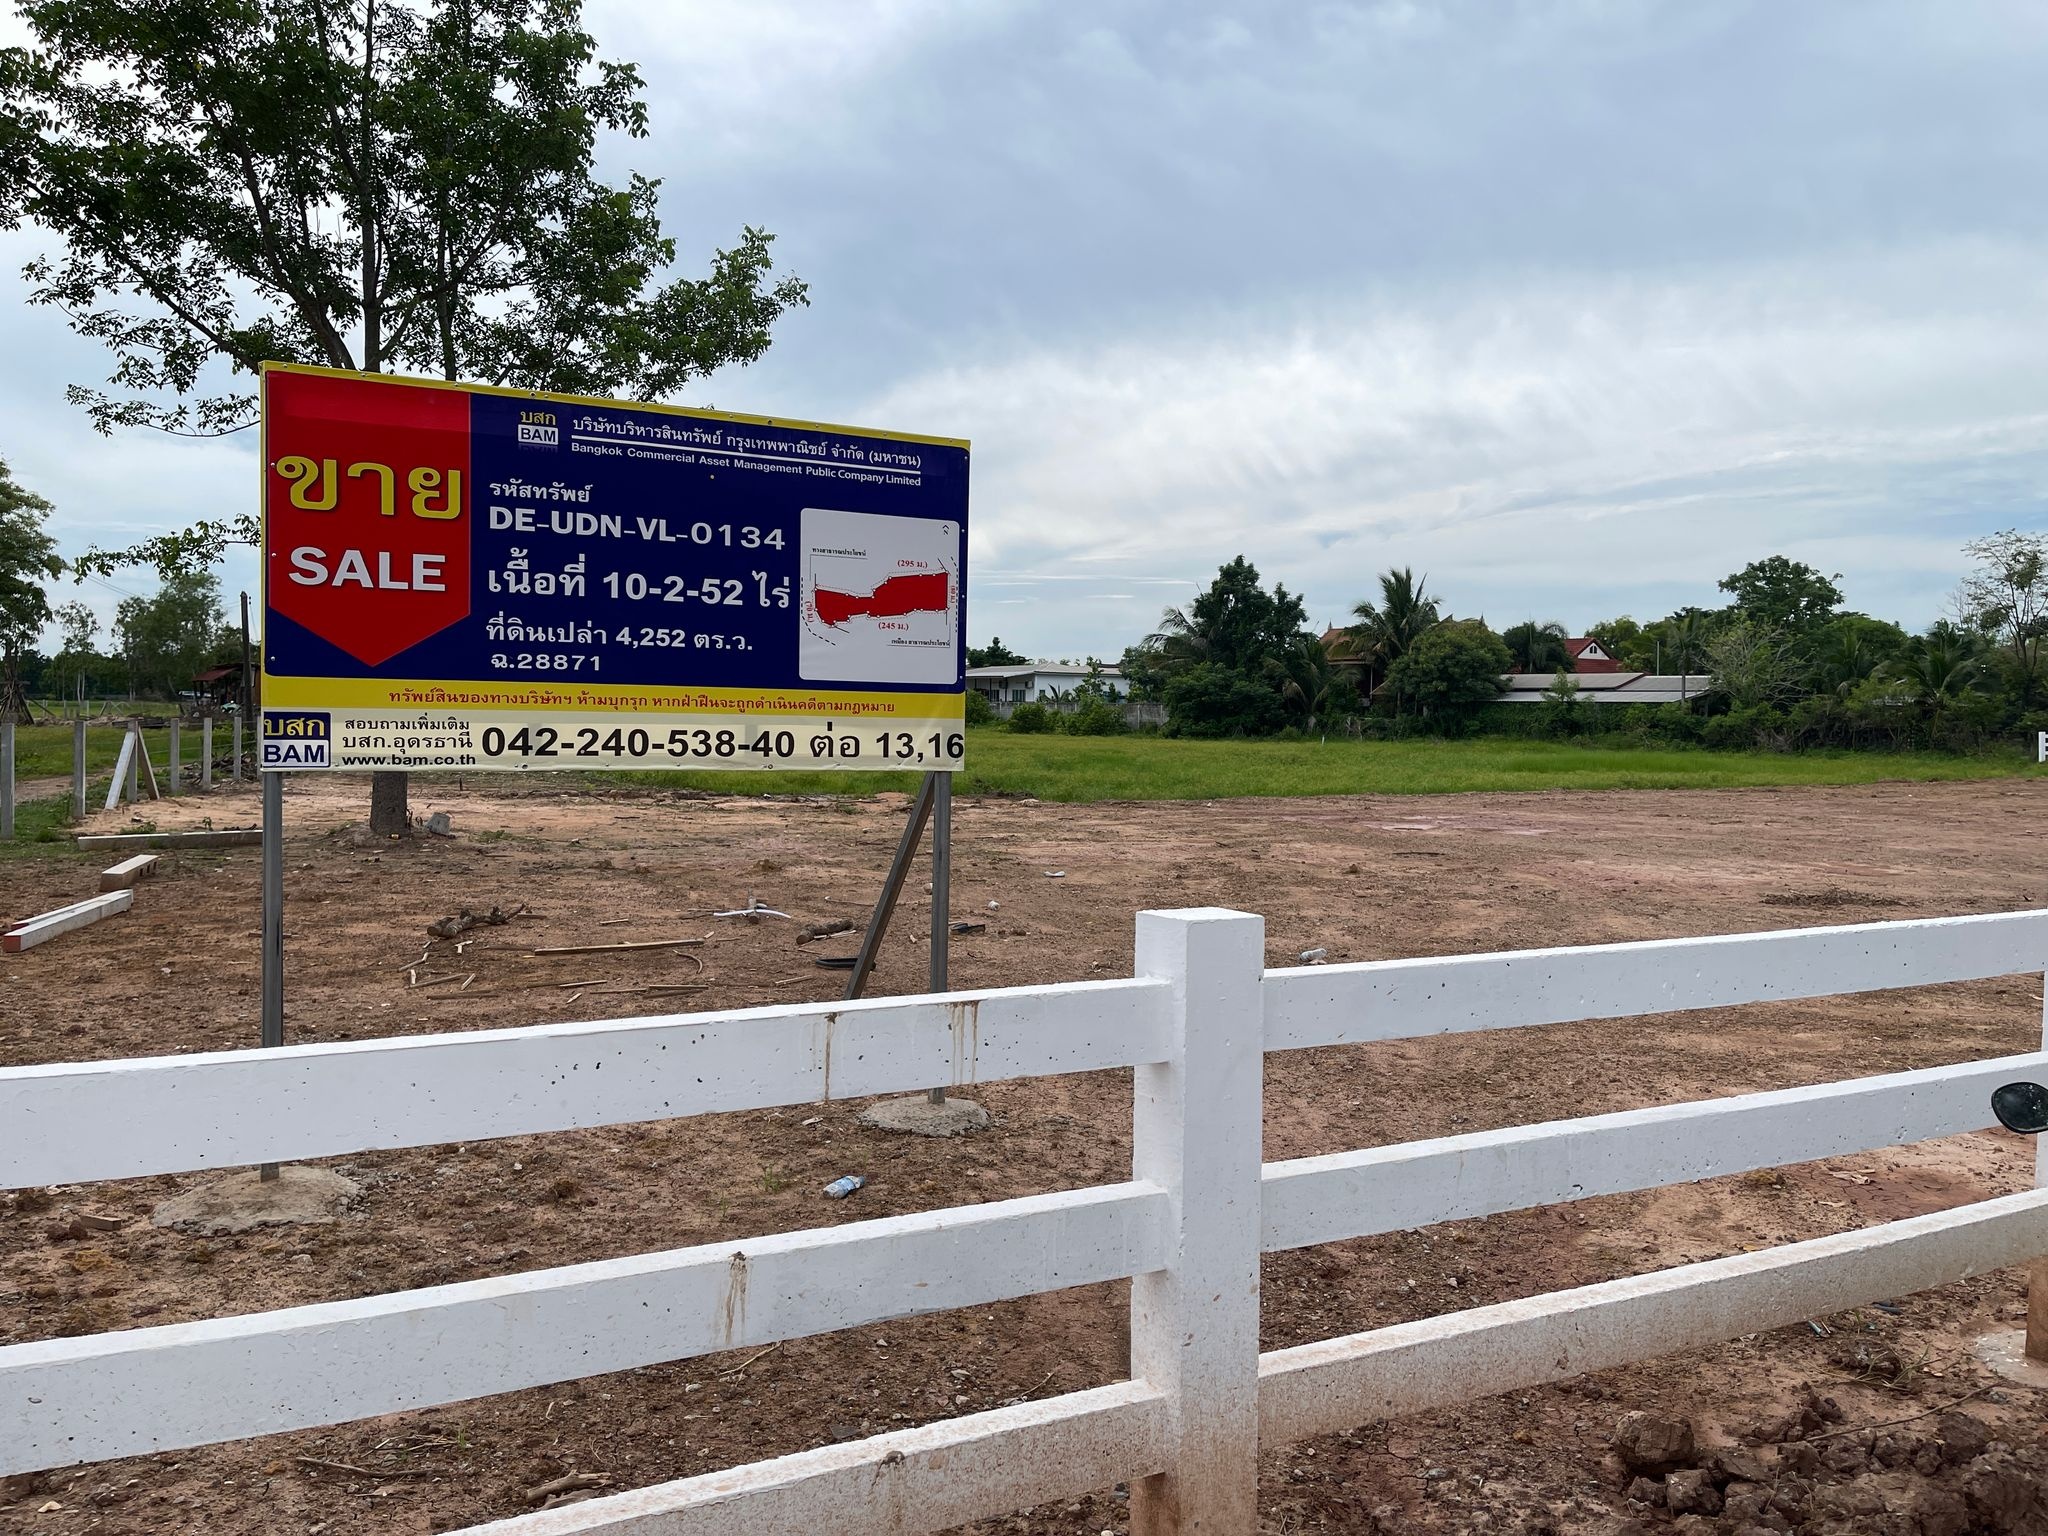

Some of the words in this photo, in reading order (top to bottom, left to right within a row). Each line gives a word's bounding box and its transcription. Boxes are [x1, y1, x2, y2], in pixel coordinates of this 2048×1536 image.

[520, 410, 556, 426] บสก
[520, 427, 556, 443] BAM
[573, 416, 723, 445] บริษัทบริหารสินทรัพย์
[727, 434, 829, 456] กรุงเทพพาณิชย์
[831, 444, 864, 460] จำกัด
[869, 450, 922, 469] (มหาชน)
[571, 442, 623, 457] Bangkok
[627, 448, 695, 464] Commercial
[699, 455, 730, 467] Asset
[734, 459, 802, 474] Management
[806, 466, 837, 478] Public
[838, 470, 884, 484] Company
[886, 475, 921, 486] Limited
[276, 455, 461, 520] ขาย
[489, 478, 593, 503] รหัสทรัพย์
[489, 506, 786, 550] DE-UDN-VL-0134
[288, 546, 446, 592] SALE
[897, 560, 915, 568] (295
[488, 547, 586, 597] เนื้อที่
[603, 571, 743, 606] 10-2-52
[751, 570, 791, 608] ไร่
[486, 611, 607, 644] ที่ดินเปล่า
[616, 626, 686, 649] 4,252
[693, 633, 753, 650] ตร.ว.
[878, 622, 896, 631] (245
[490, 652, 600, 671] ฉ.28871
[389, 687, 572, 706] ทรัพย์สินของทางบริษัทฯ
[577, 691, 648, 710] ห้ามบุกรุก
[652, 694, 895, 715] หากฝ่าฝืนจะถูกดำเนินคดีตามกฎหมาย
[264, 716, 326, 738] บสก
[344, 712, 471, 731] สอบถามเพิ่มเติม
[264, 744, 326, 764] BAM
[342, 731, 474, 755] บสก.อุดรธานี
[482, 726, 795, 758] 042-240-538-40
[809, 721, 860, 758] ต่อ
[876, 732, 965, 763] 13,16
[342, 754, 477, 766] www.bam.co.th
